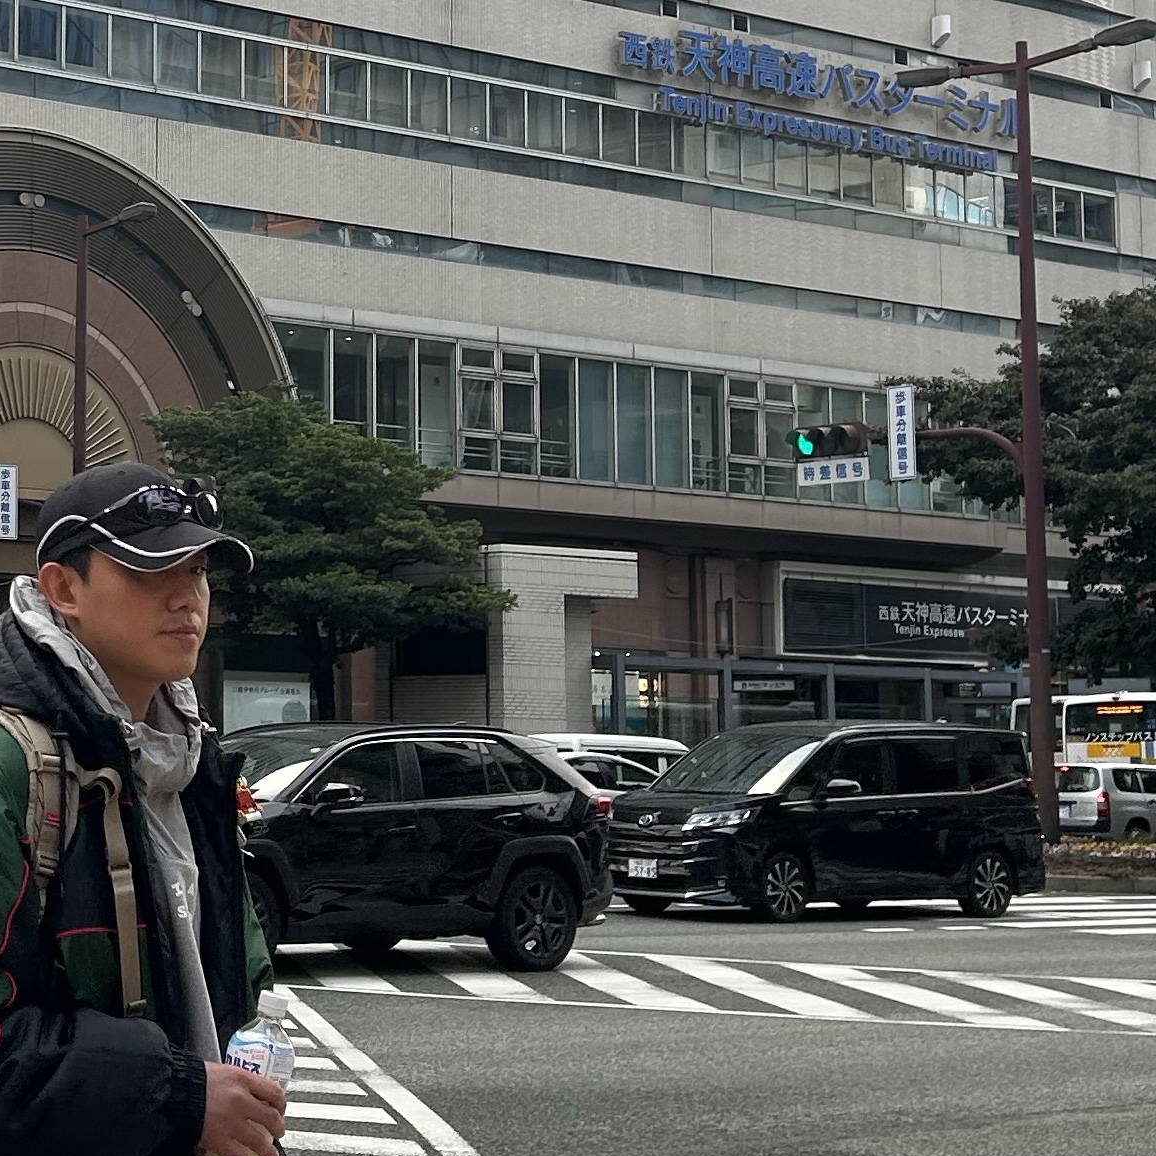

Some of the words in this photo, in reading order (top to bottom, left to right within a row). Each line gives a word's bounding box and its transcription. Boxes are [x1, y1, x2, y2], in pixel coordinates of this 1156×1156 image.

[660, 86, 729, 124] Tenjin
[737, 101, 862, 151] Expressway
[870, 125, 911, 156] Bus
[916, 134, 998, 171] Terminal
[895, 390, 909, 475] 歩車分離信号
[1, 469, 10, 535] 歩車分離信号
[894, 623, 921, 637] Tenjin
